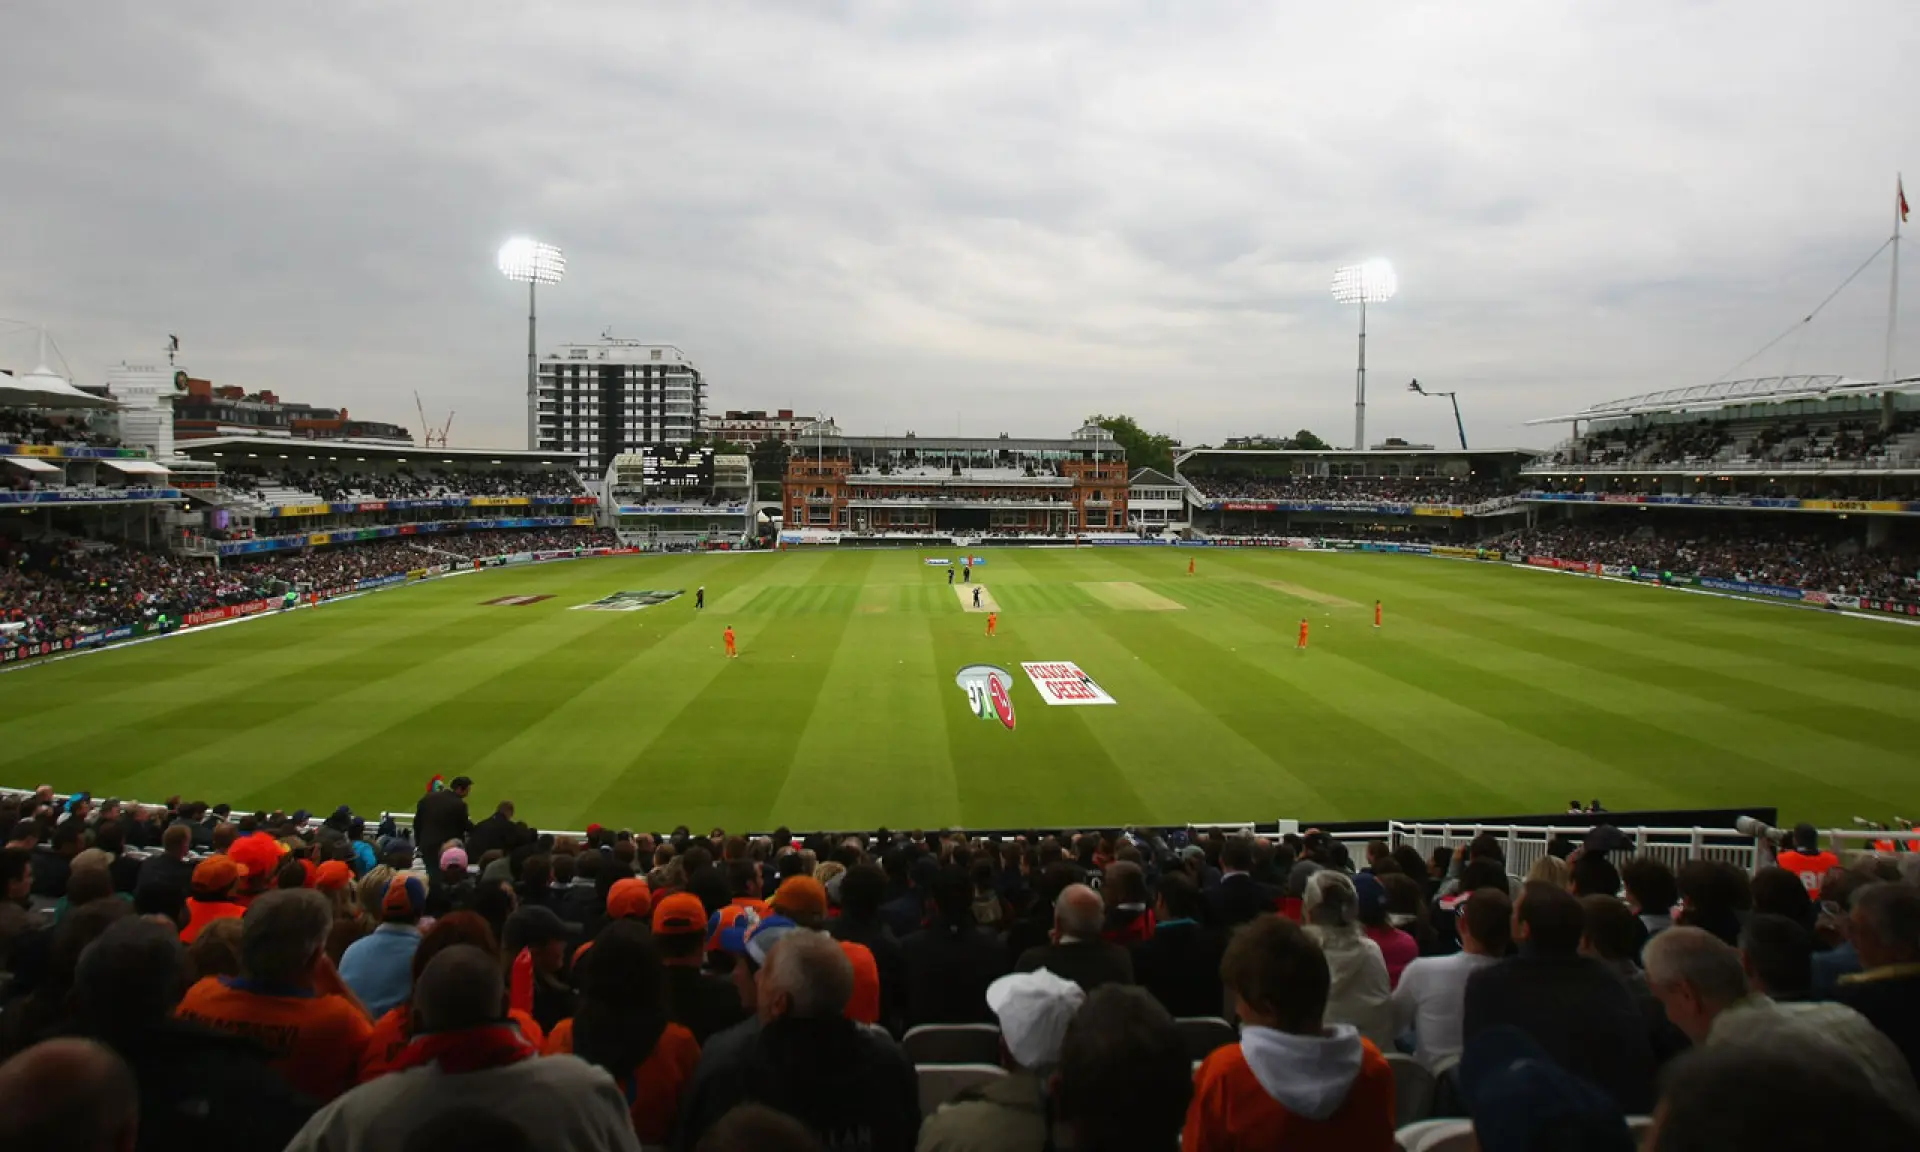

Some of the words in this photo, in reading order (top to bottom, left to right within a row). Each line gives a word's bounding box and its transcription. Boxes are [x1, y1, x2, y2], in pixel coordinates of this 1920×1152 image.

[4, 650, 16, 660] LG
[29, 645, 40, 655] LG
[1024, 664, 1076, 679] HONDA
[1045, 680, 1097, 700] HERO
